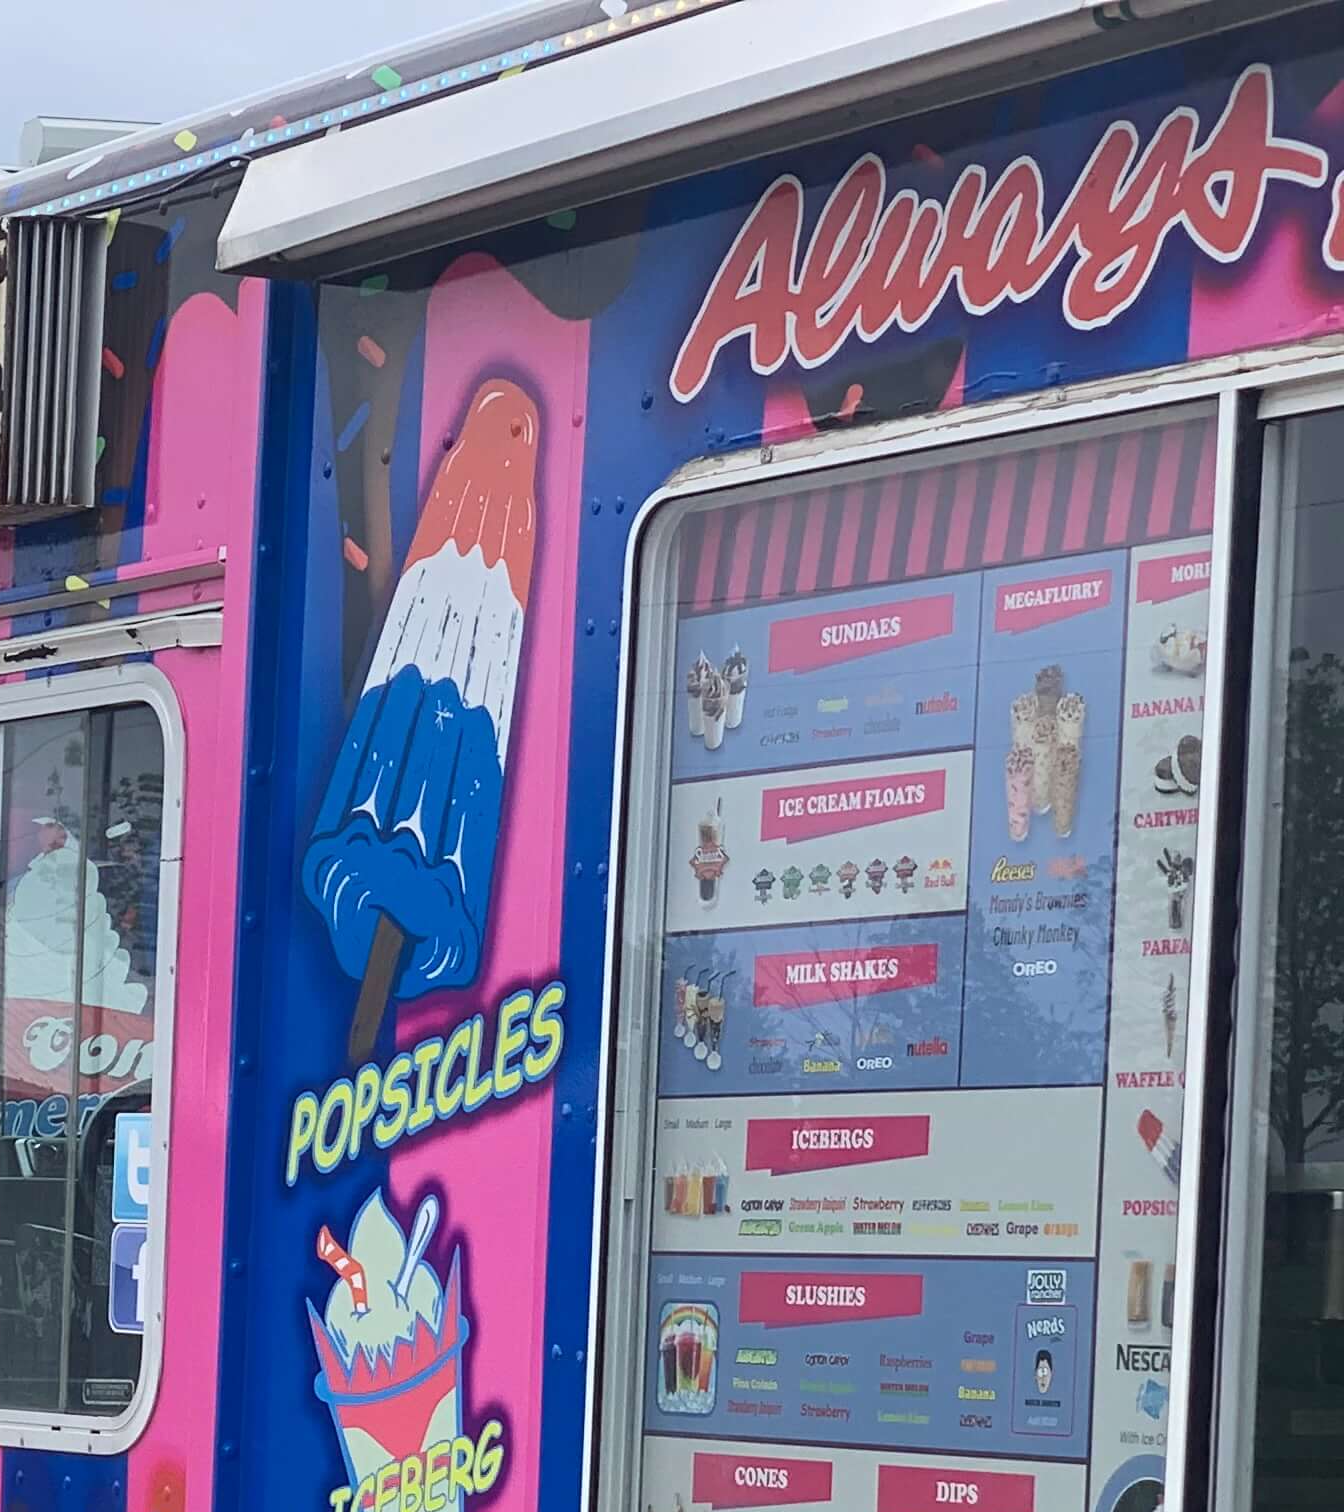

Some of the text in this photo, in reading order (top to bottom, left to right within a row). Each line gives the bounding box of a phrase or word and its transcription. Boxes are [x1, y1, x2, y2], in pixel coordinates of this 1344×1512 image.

[669, 63, 1327, 403] Always
[1003, 579, 1103, 612] MEGAFLURRY
[820, 615, 902, 648] SUNDAES
[1131, 699, 1195, 719] BANANA
[778, 784, 925, 818] ICE CREAM FLOATS
[786, 958, 899, 985] MILK SHAKES
[1013, 959, 1058, 978] OREO
[856, 1056, 893, 1070] OREO
[286, 981, 566, 1187] POPSICLES
[1115, 1070, 1175, 1089] WAFFLE
[791, 1127, 874, 1150] ICEBERGS
[852, 1196, 904, 1213] Strawberry
[1006, 1221, 1039, 1237] Grape
[1030, 1274, 1062, 1290] JOLLY
[784, 1284, 866, 1307] SLUSHIES
[1116, 1343, 1172, 1373] NESCA
[734, 1466, 788, 1489] CONES
[935, 1480, 979, 1505] DIPS
